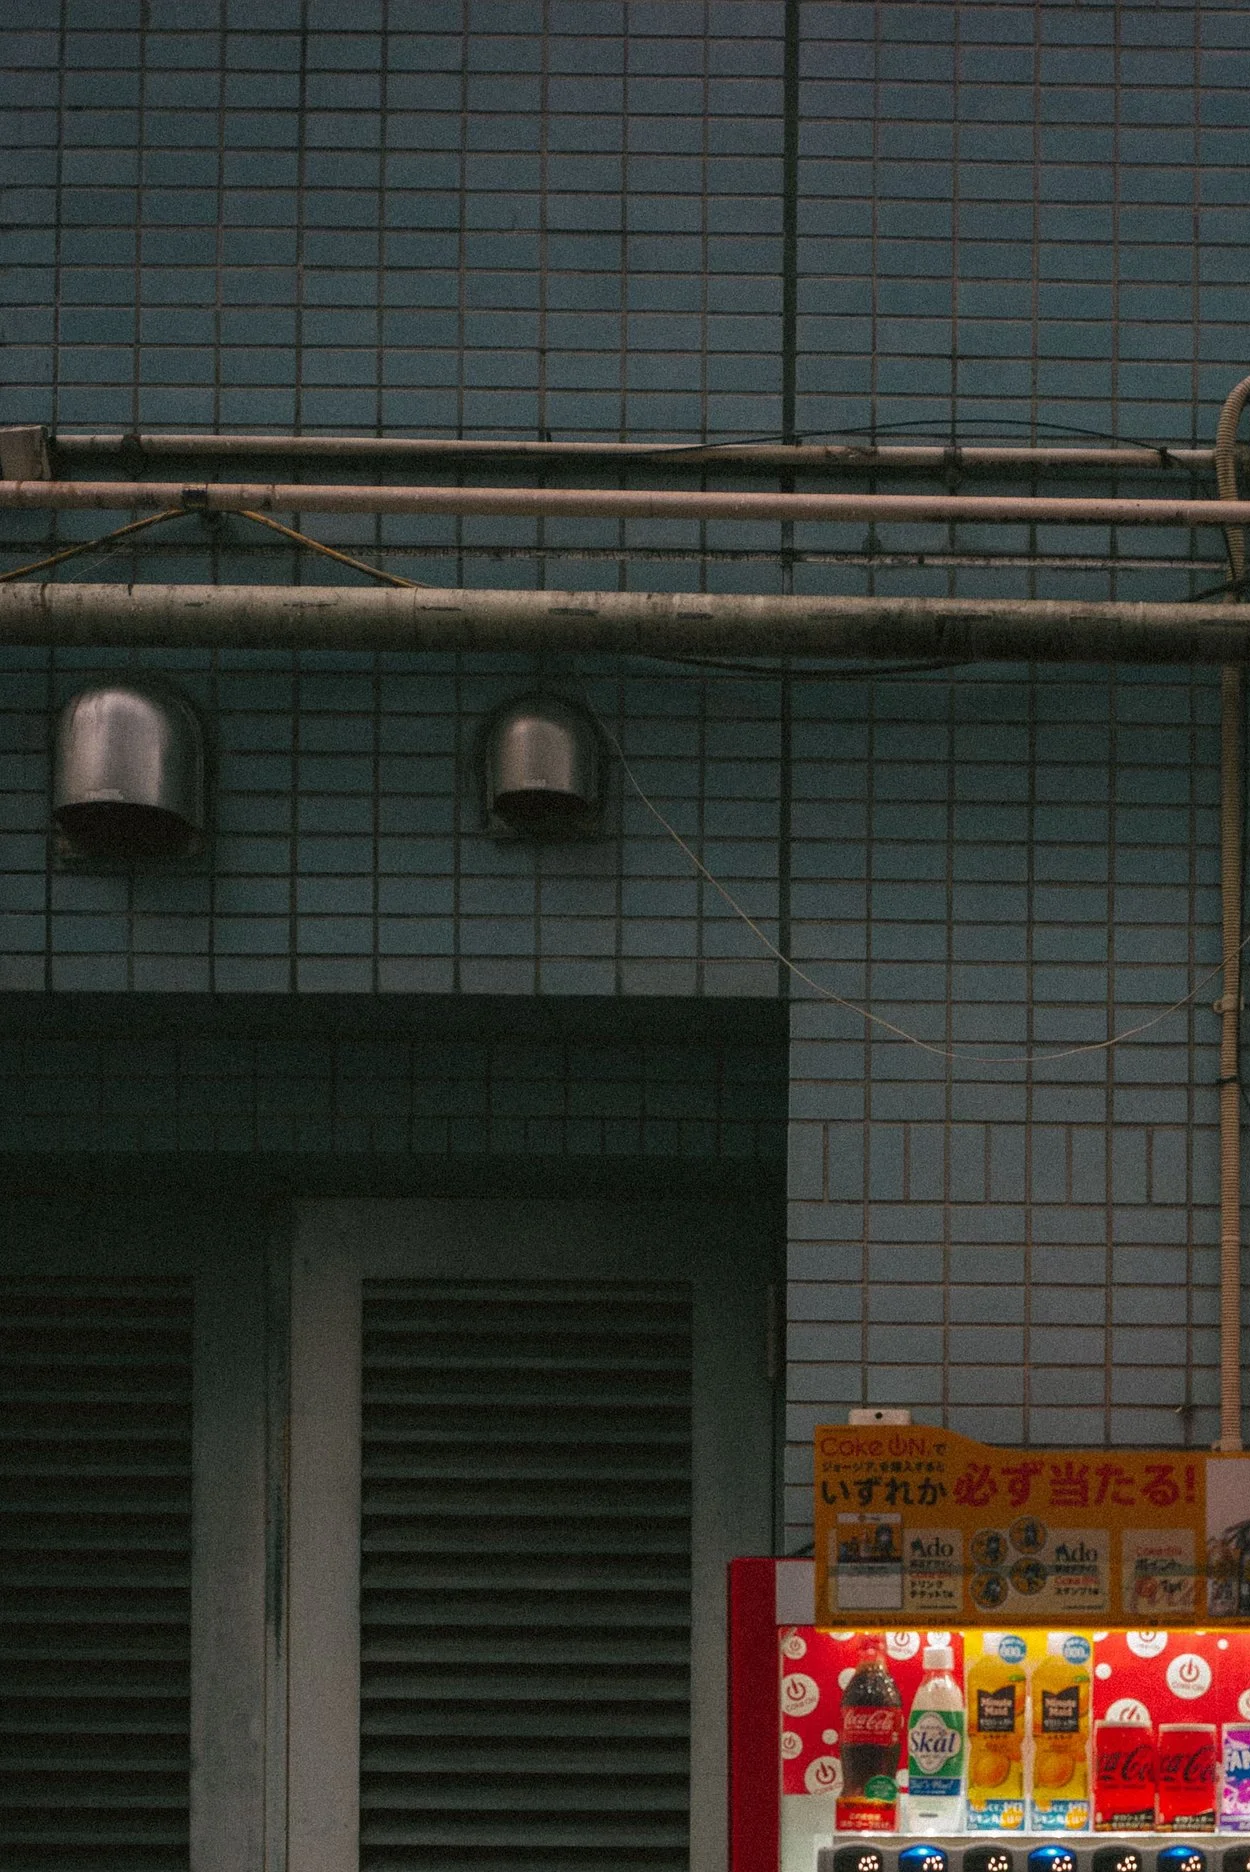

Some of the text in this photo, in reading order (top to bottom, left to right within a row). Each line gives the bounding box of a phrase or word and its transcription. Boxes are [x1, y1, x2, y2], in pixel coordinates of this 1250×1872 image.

[820, 1436, 884, 1456] Coke
[821, 1460, 1196, 1507] いずれか 必ず当たる!
[910, 1537, 954, 1558] Ado
[1054, 1542, 1098, 1562] Ado
